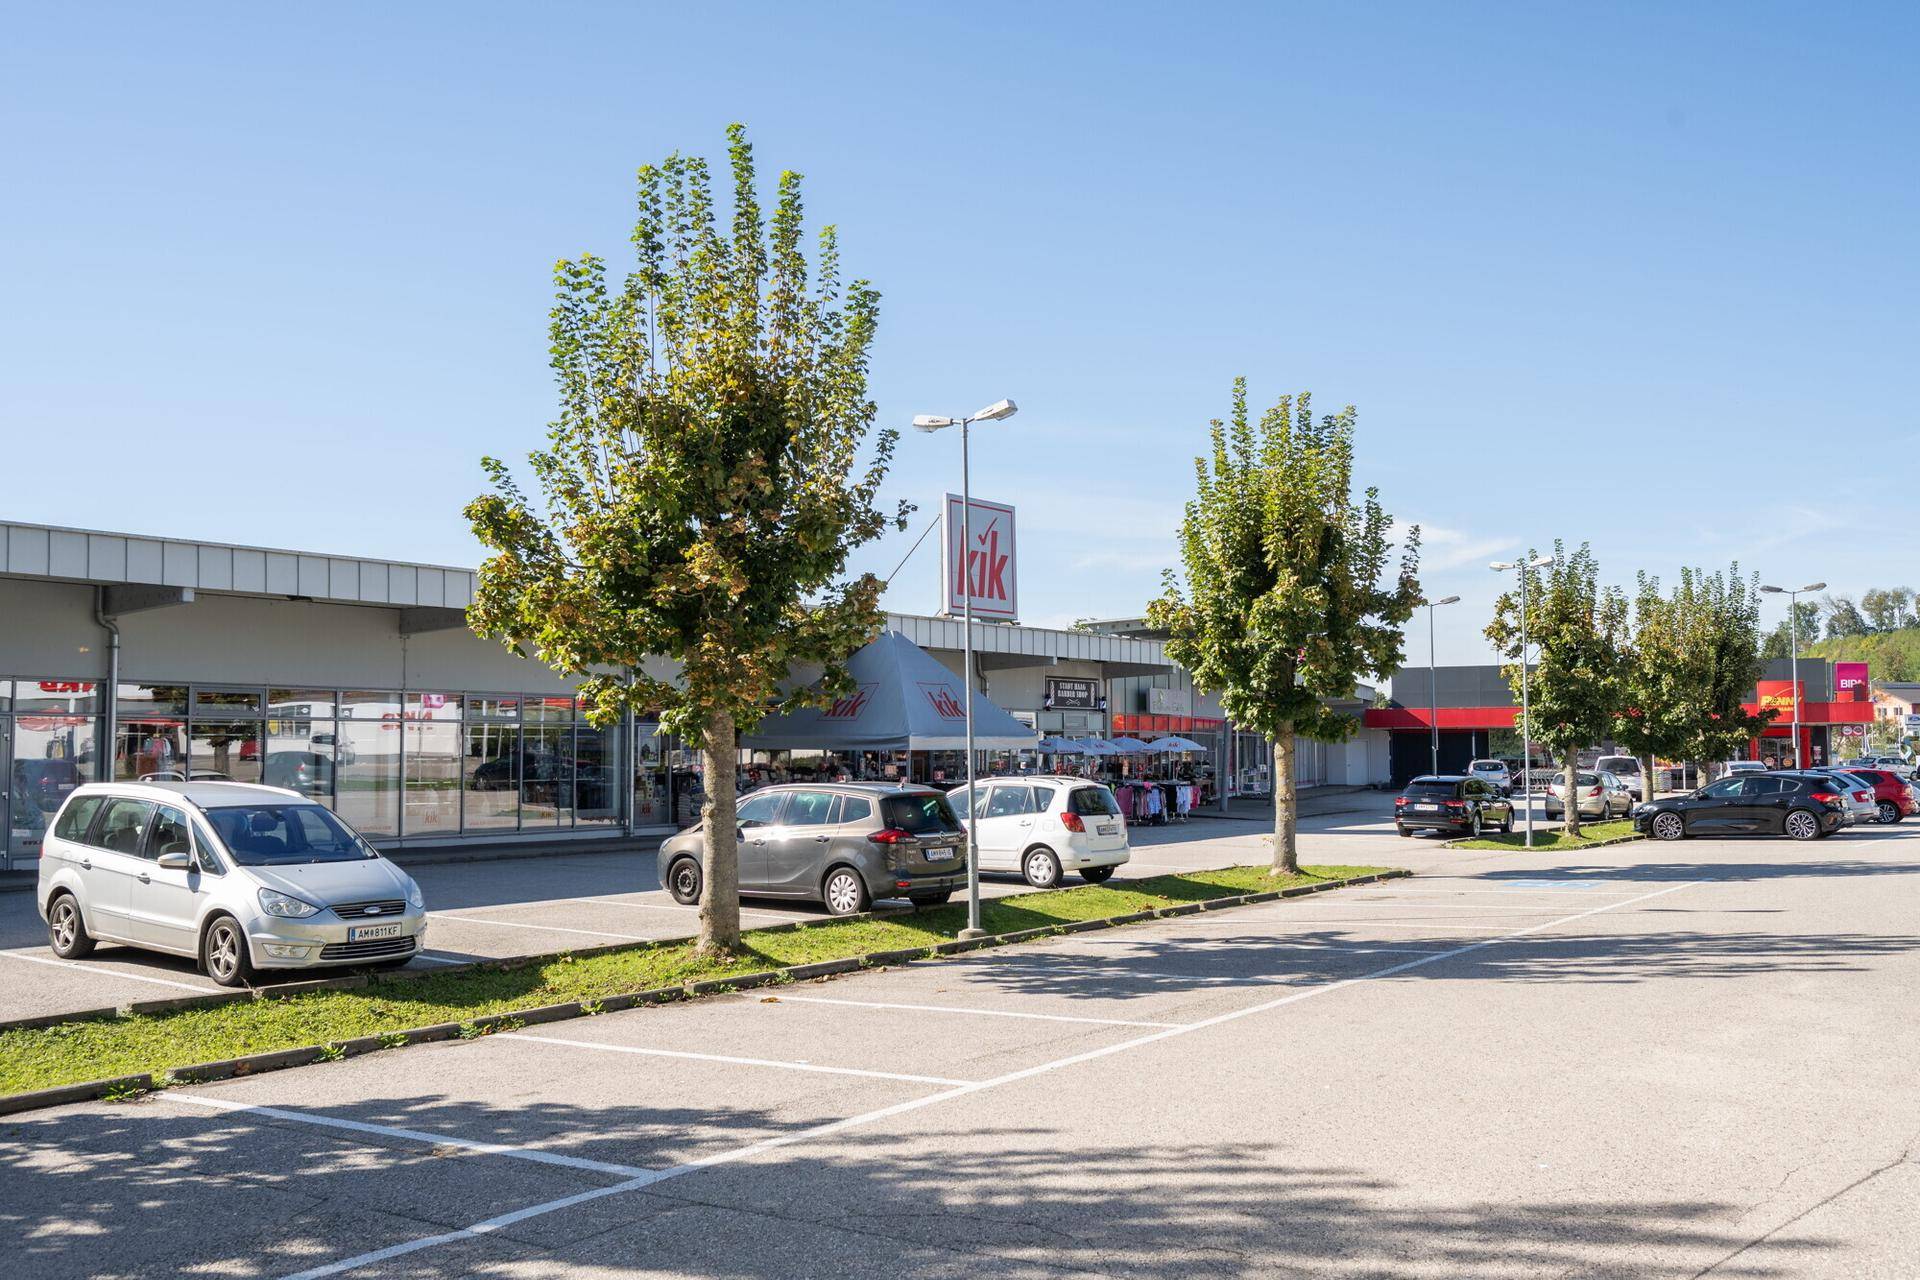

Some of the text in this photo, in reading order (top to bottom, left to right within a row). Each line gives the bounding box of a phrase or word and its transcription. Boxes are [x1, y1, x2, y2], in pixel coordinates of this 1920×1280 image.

[956, 517, 1009, 601] kik
[1057, 690, 1089, 699] BARBER SHOP
[1059, 682, 1074, 690] STADT
[927, 687, 967, 718] kik
